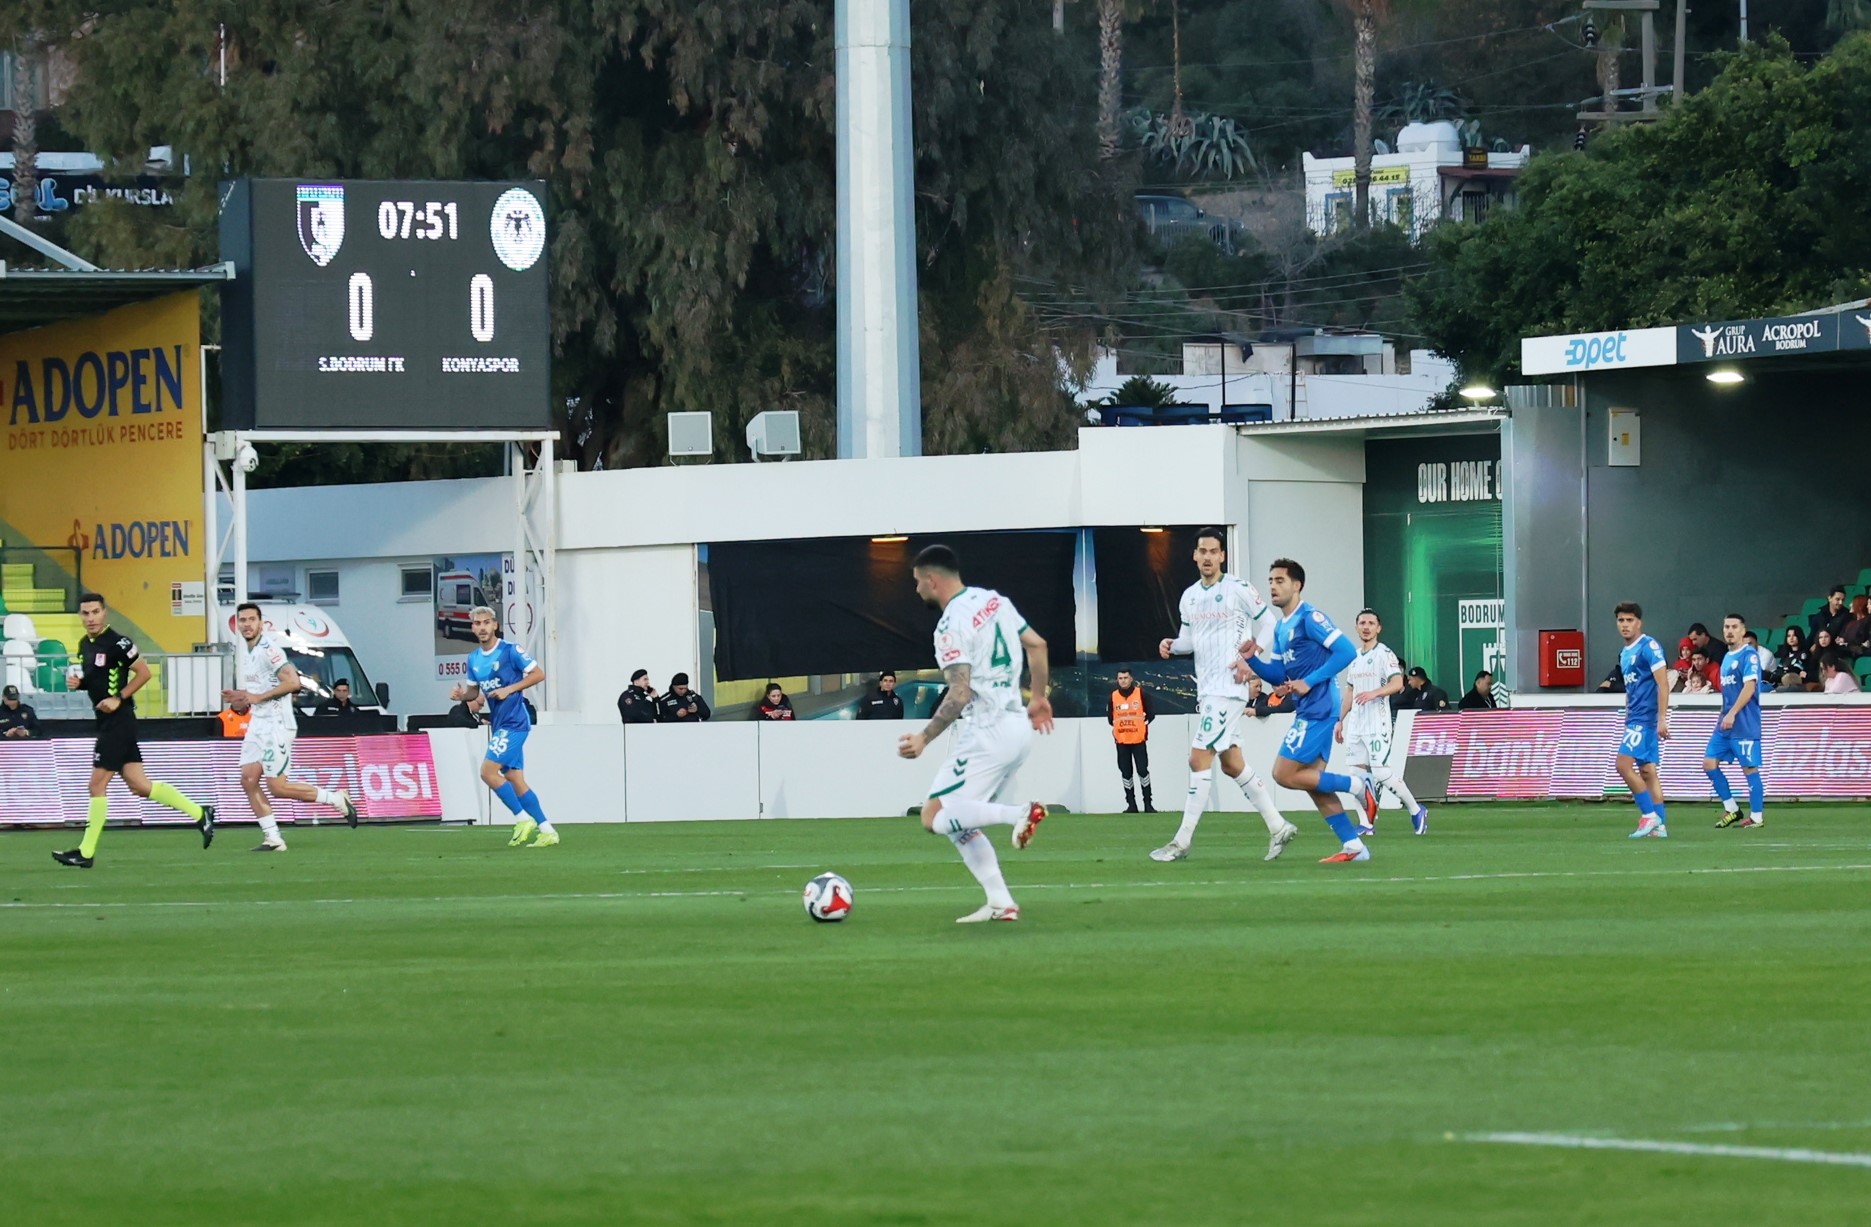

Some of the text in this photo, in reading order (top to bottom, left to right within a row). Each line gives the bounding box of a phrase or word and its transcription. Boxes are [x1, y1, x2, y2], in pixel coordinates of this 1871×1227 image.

[378, 201, 458, 240] 07:51
[348, 272, 494, 342] 0 0
[1725, 325, 1745, 336] GRUP
[1762, 320, 1822, 342] ACROPOL
[1716, 335, 1756, 355] AURA
[1775, 339, 1806, 350] BODRUM
[442, 357, 520, 372] KONYASPOR
[9, 344, 183, 425] ADOPEN
[9, 421, 183, 450] DÖRT DÖRTLÜK PENCERE
[1418, 462, 1447, 503] OUR
[1451, 460, 1492, 501] HOME
[93, 520, 189, 560] ADOPEN
[991, 622, 1011, 668] 4
[446, 662, 460, 675] 555
[1567, 657, 1578, 666] 112
[489, 736, 509, 753] 35
[1369, 739, 1381, 752] 10
[1622, 729, 1642, 745] 70
[1738, 740, 1754, 756] 17
